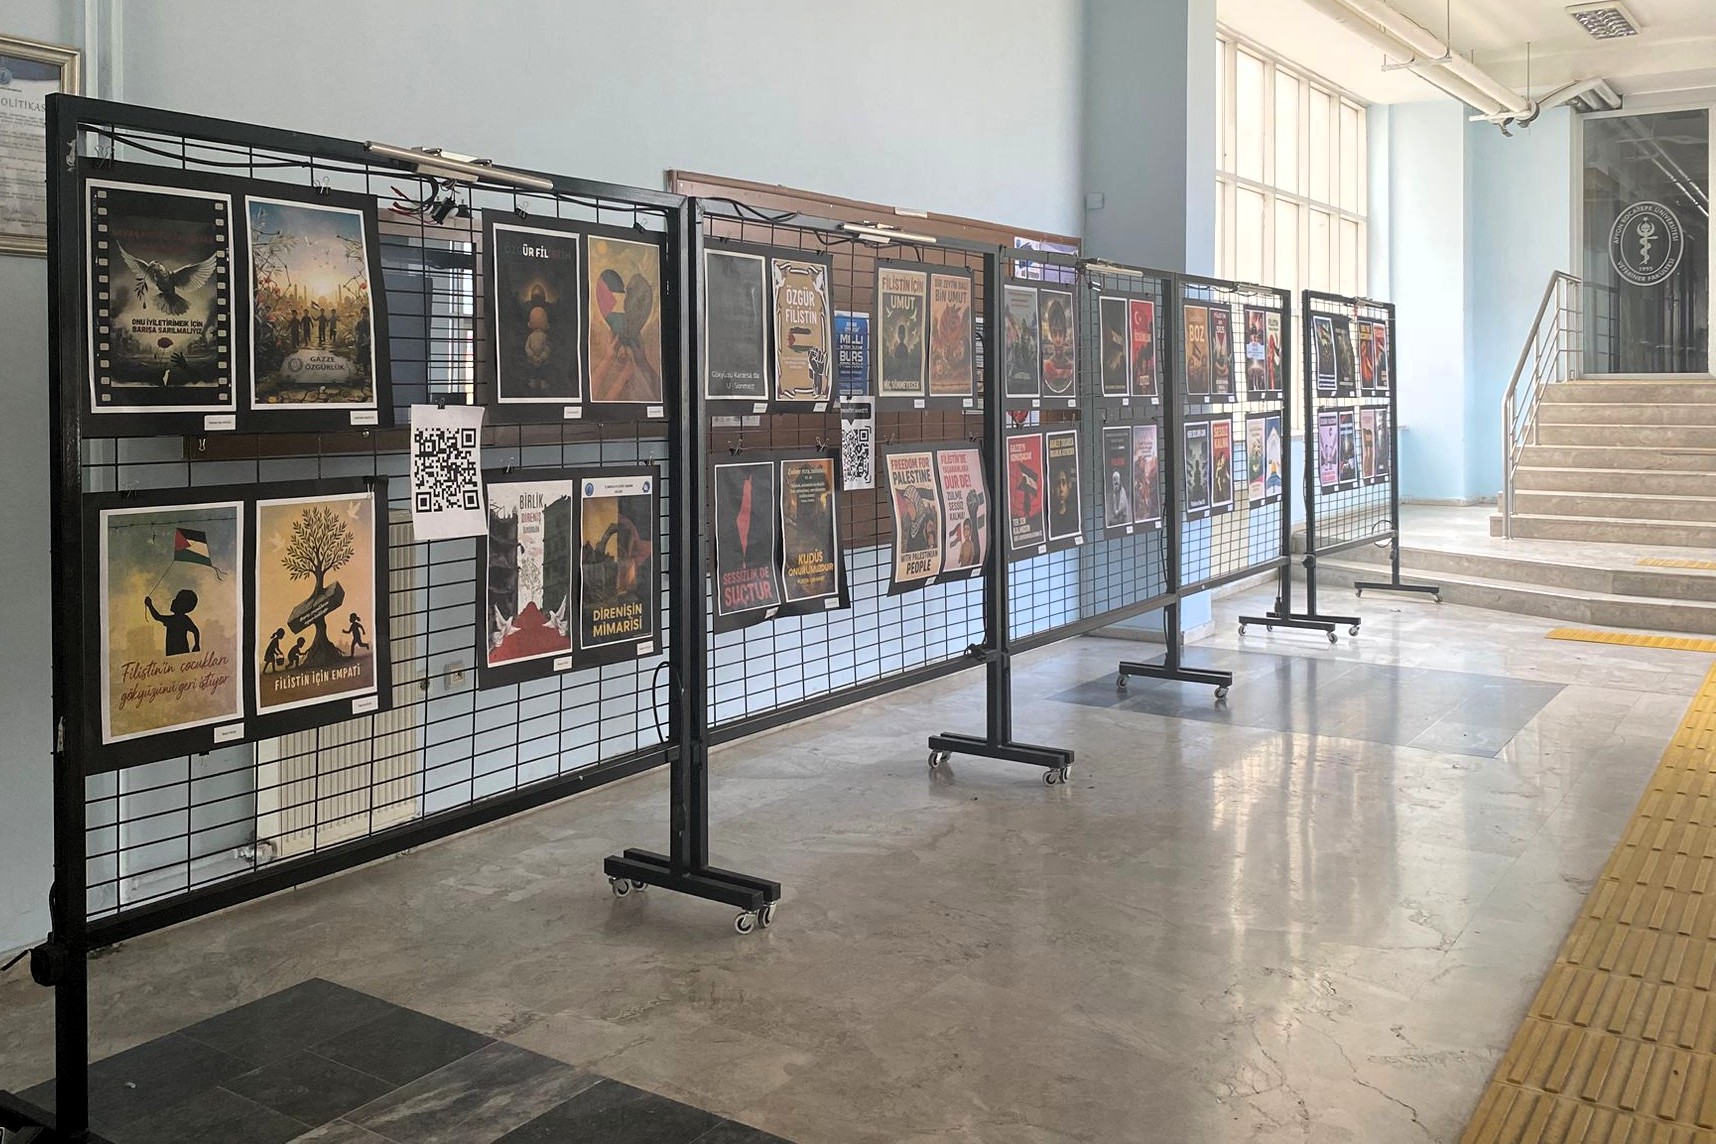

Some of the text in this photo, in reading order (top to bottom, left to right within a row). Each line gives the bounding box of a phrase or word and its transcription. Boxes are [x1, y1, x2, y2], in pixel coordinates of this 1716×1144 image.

[1622, 205, 1652, 224] KOCATEPE
[1616, 258, 1676, 281] VETERİNER FAKÜLTESİ
[786, 284, 815, 307] ÖZGÜR
[890, 295, 915, 310] UMUT
[948, 290, 967, 304] UMUT
[190, 320, 203, 328] İÇİN
[785, 306, 817, 325] FİLİSTİN
[132, 326, 156, 335] BARIŞA
[1188, 324, 1205, 343] BOZ
[840, 351, 863, 362] BURS
[305, 363, 345, 371] ÖZGÜRLÜK
[890, 457, 930, 470] FREEDOM FOR
[892, 469, 932, 485] PALESTINE
[944, 473, 972, 489] DUR DE!
[519, 492, 544, 510] BİRLİK
[759, 566, 770, 579] DE
[906, 559, 931, 575] PEOPLE
[724, 581, 772, 606] SUÇTUR
[593, 602, 643, 622] DİRENİŞİN
[592, 618, 643, 637] MİMARİSİ
[121, 660, 175, 683] Filistin'in
[275, 663, 361, 691] FİLİSTİN İÇİN EMPATİ
[119, 671, 231, 710] gökyüzünü geri istiyor
